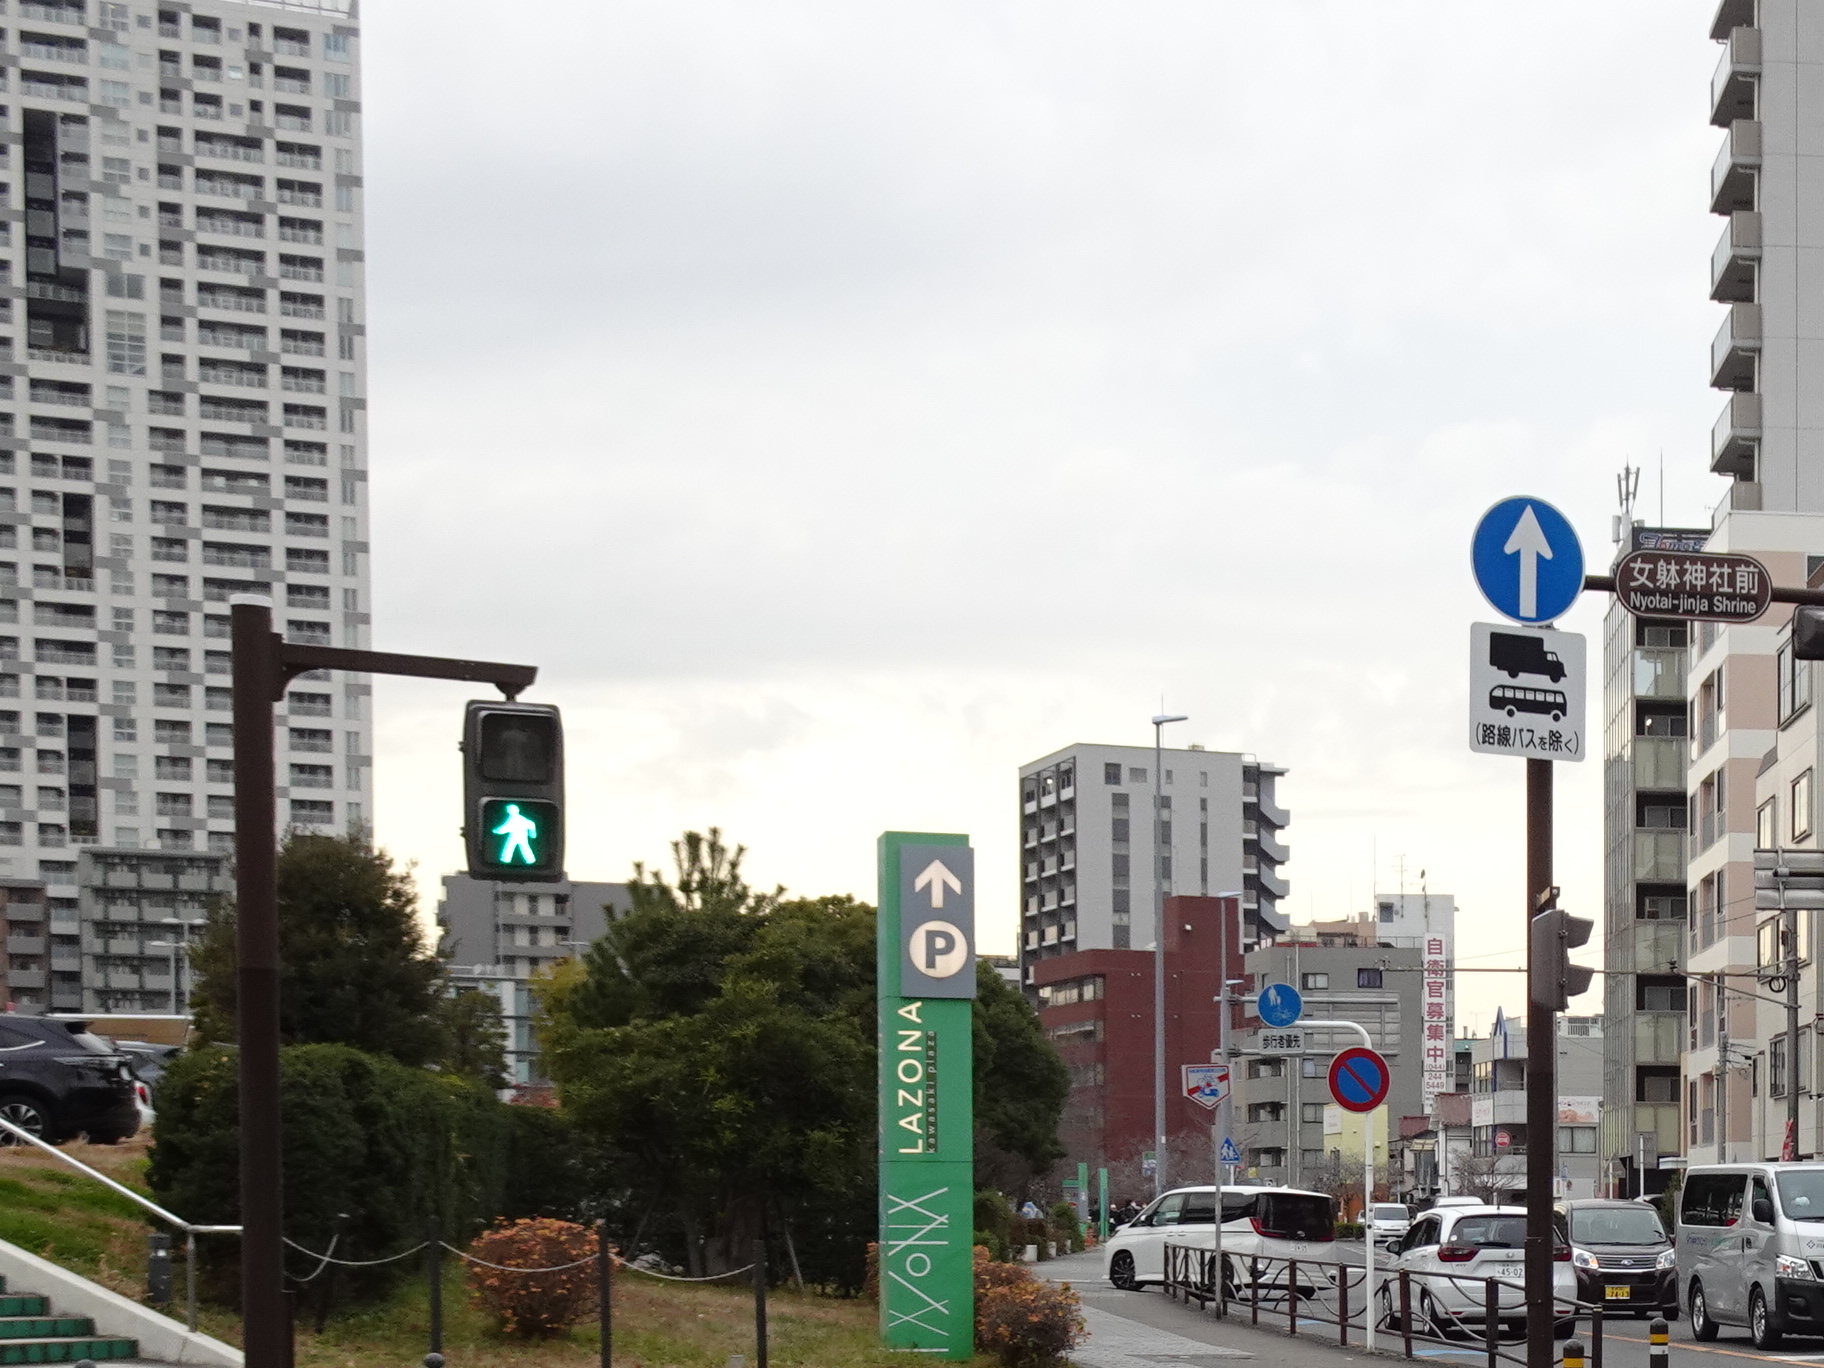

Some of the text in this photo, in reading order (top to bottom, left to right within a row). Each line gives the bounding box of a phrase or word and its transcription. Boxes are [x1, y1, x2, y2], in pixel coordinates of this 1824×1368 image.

[1629, 557, 1760, 595] 女躰神社前
[1629, 591, 1757, 614] Nyotai-jinja Shrine
[925, 929, 956, 969] P
[1426, 937, 1445, 1063] 自衛官募集中
[1262, 1033, 1301, 1049] 歩行者優先
[897, 1001, 923, 1154] LAZONA
[926, 1030, 937, 1154] kawasaki plaza
[1426, 1081, 1445, 1090] 5449
[1428, 1072, 1442, 1081] 244
